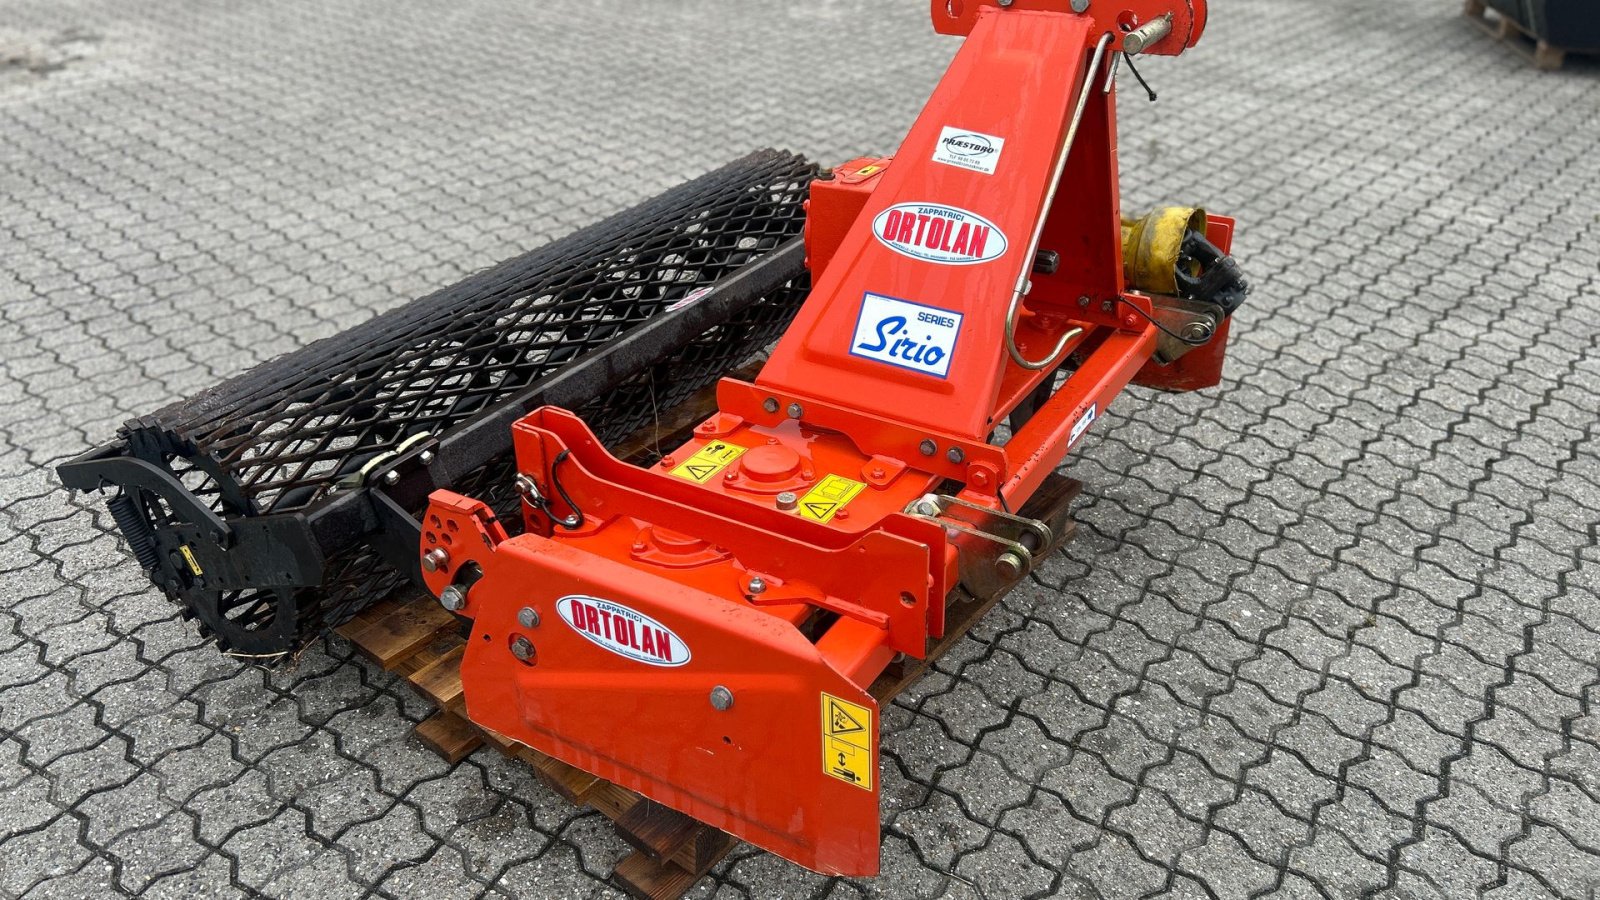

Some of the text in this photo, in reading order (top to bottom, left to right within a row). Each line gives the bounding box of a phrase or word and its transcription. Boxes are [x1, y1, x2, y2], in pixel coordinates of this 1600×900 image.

[942, 137, 995, 154] PRÆSTBRO
[918, 207, 965, 222] ZAPPATRICI
[882, 209, 990, 258] ORTOLAN
[917, 311, 955, 328] SERIES
[857, 315, 946, 366] Sirio
[596, 602, 642, 623] ZAPPATRICI
[570, 600, 673, 663] ORTOLAN
